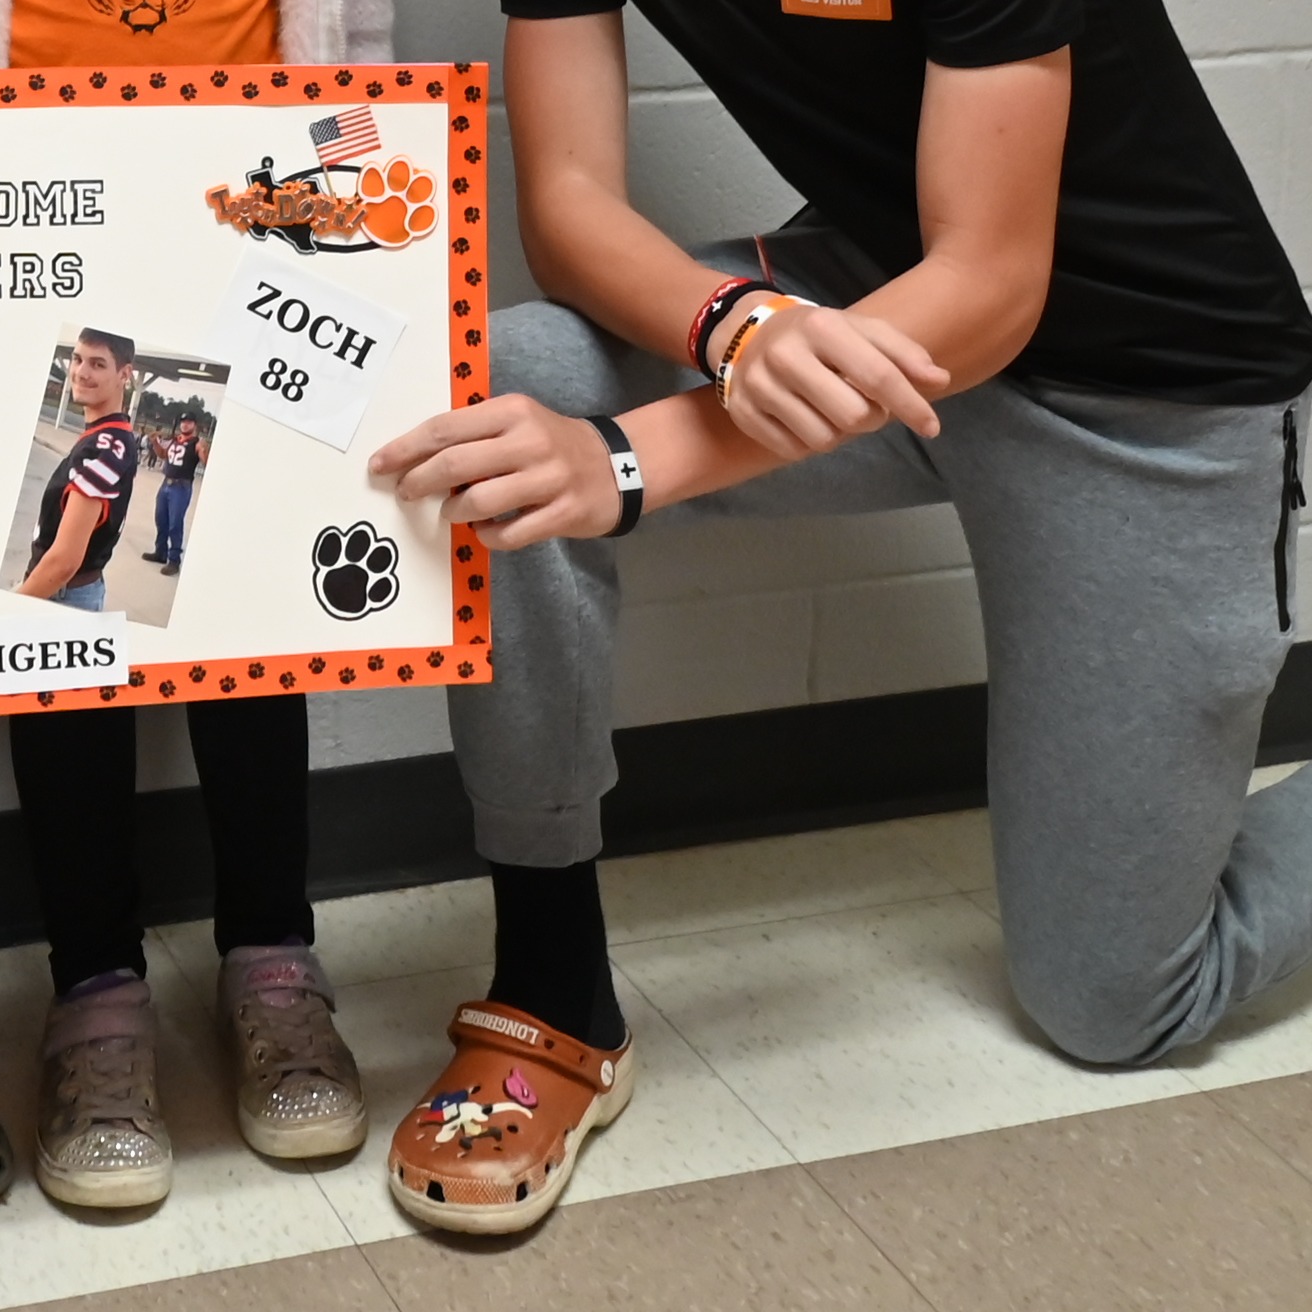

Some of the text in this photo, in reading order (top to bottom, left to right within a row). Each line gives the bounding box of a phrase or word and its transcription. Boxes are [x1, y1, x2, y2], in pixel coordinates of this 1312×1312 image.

[246, 281, 377, 370] ZOCH
[259, 357, 310, 402] 88
[92, 432, 126, 460] 53
